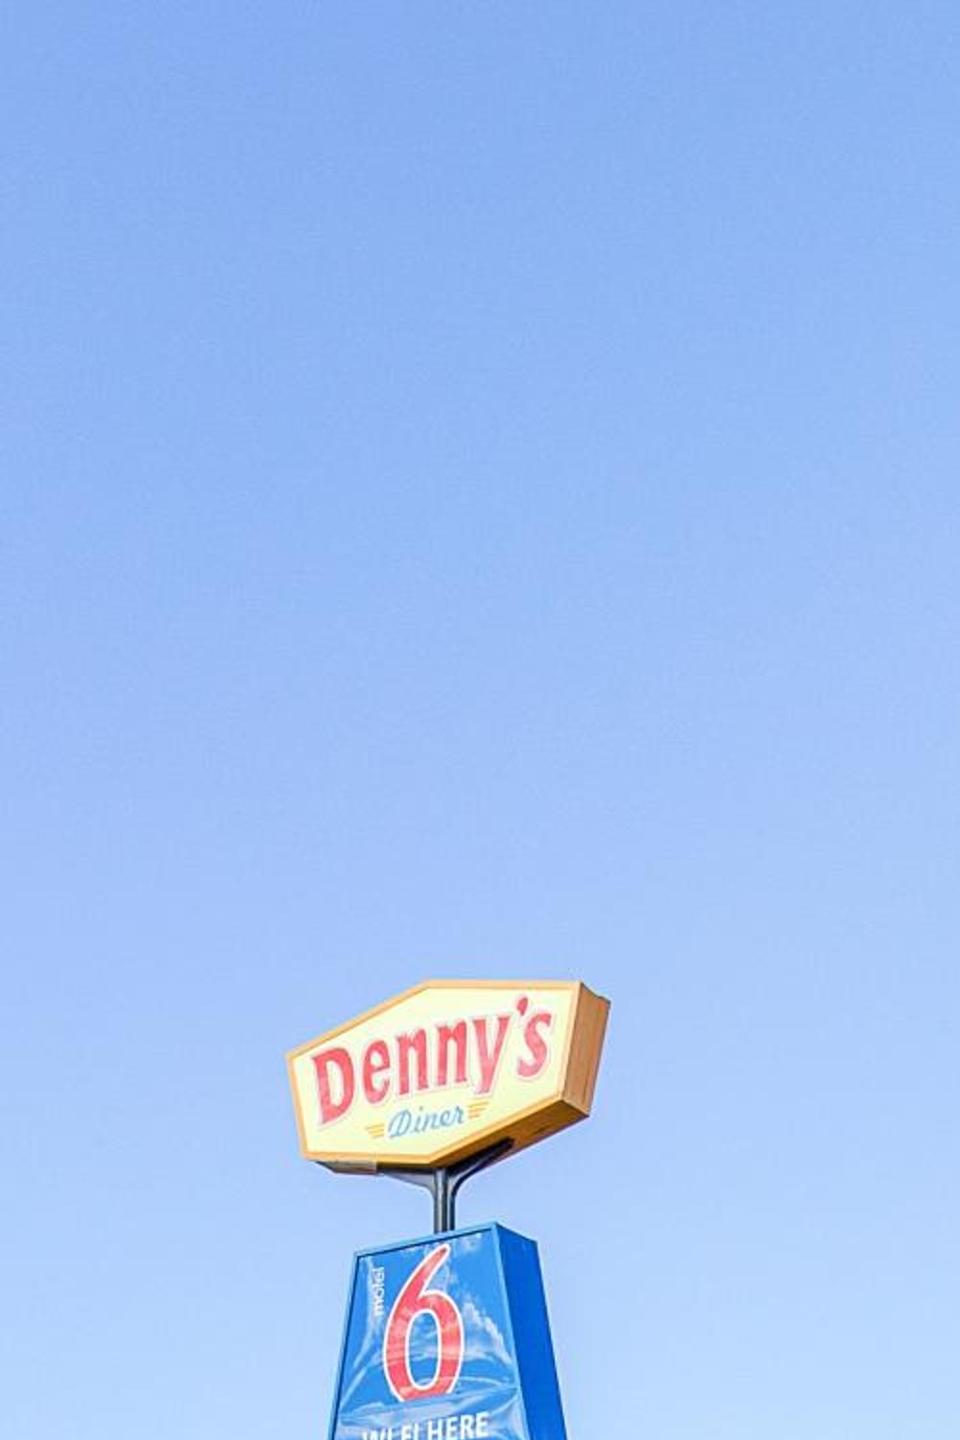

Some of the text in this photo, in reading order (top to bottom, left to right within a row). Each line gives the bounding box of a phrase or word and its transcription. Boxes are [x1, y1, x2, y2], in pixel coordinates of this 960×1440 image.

[311, 996, 552, 1125] Denny's
[388, 1105, 464, 1138] Diner
[383, 1243, 464, 1402] 6
